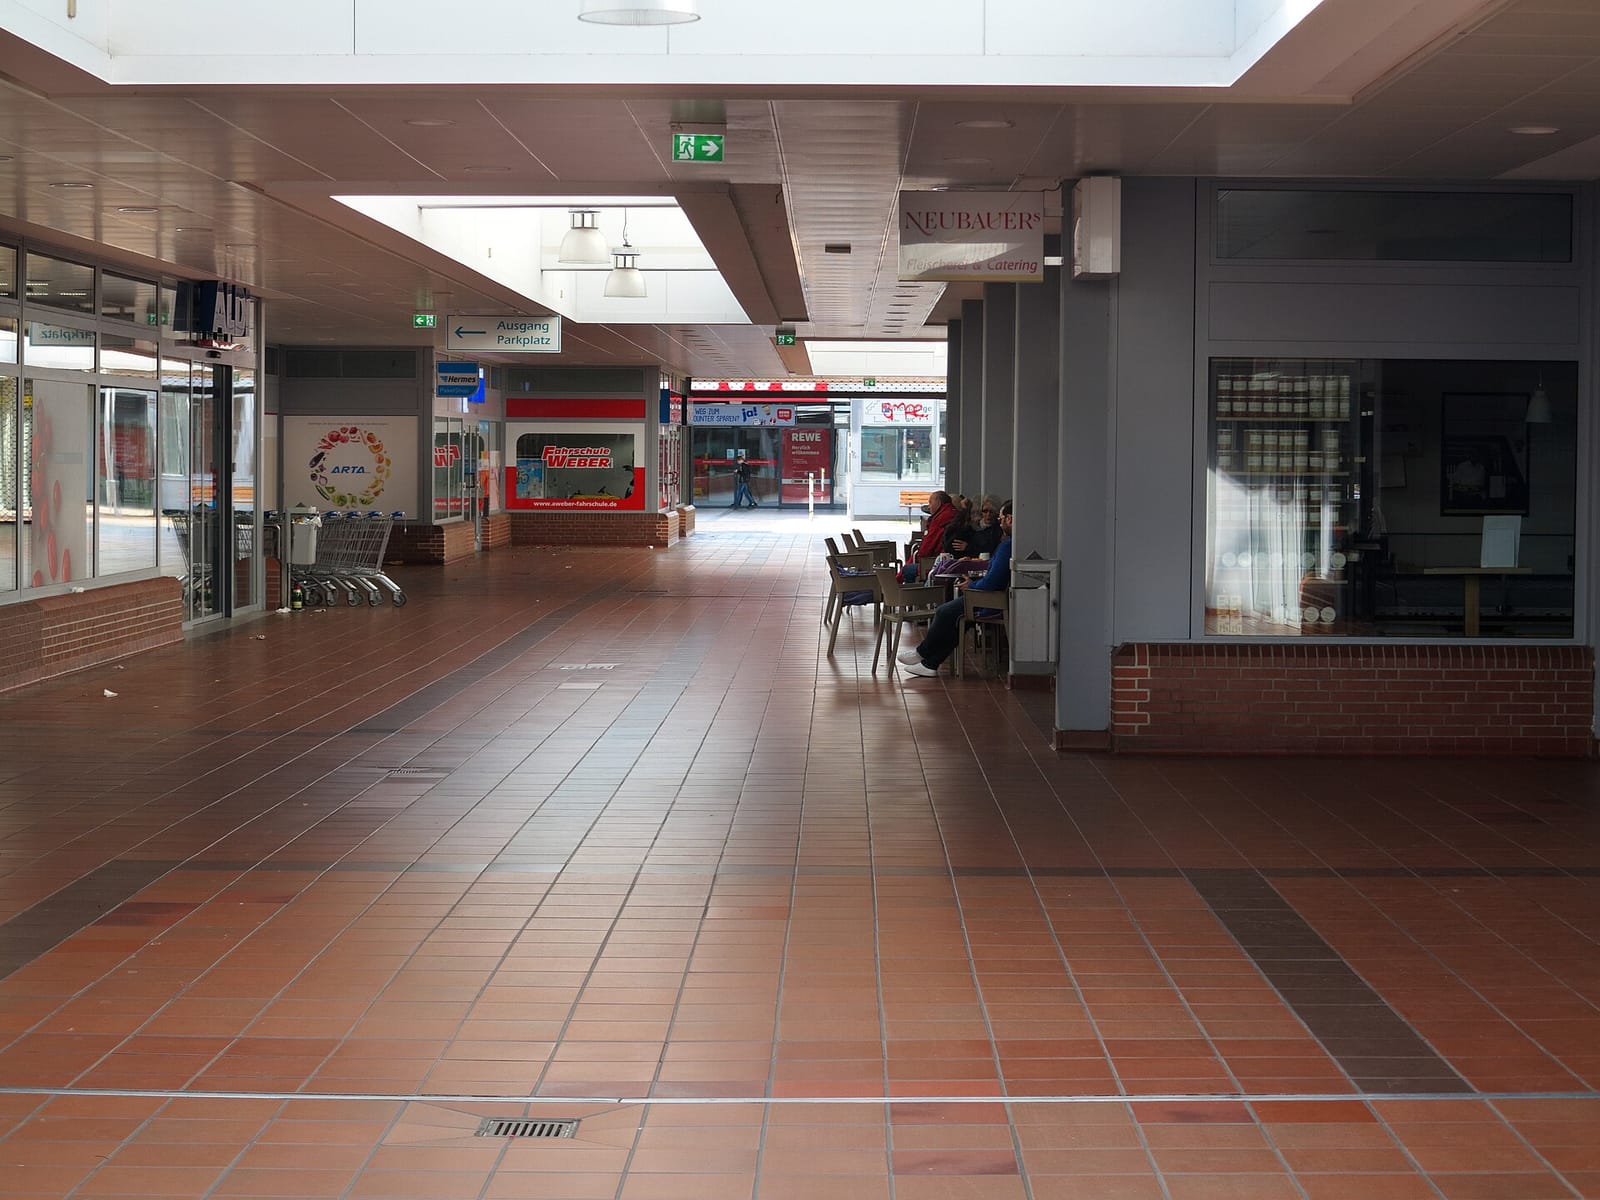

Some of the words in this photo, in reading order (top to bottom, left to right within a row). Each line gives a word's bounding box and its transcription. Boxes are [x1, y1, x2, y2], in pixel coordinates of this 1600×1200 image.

[906, 258, 968, 271] Fleischerei
[972, 259, 982, 271] &
[987, 259, 1038, 273] Catering
[496, 320, 550, 333] Ausgang
[497, 335, 551, 347] Parkplatz
[447, 375, 476, 383] Hermes
[694, 407, 707, 415] WEG
[708, 407, 720, 415] ZUM
[741, 406, 758, 422] ja!
[791, 432, 822, 442] REWE
[542, 446, 611, 459] Fahrschule
[547, 456, 610, 468] WEBER
[330, 465, 366, 473] ARTA
